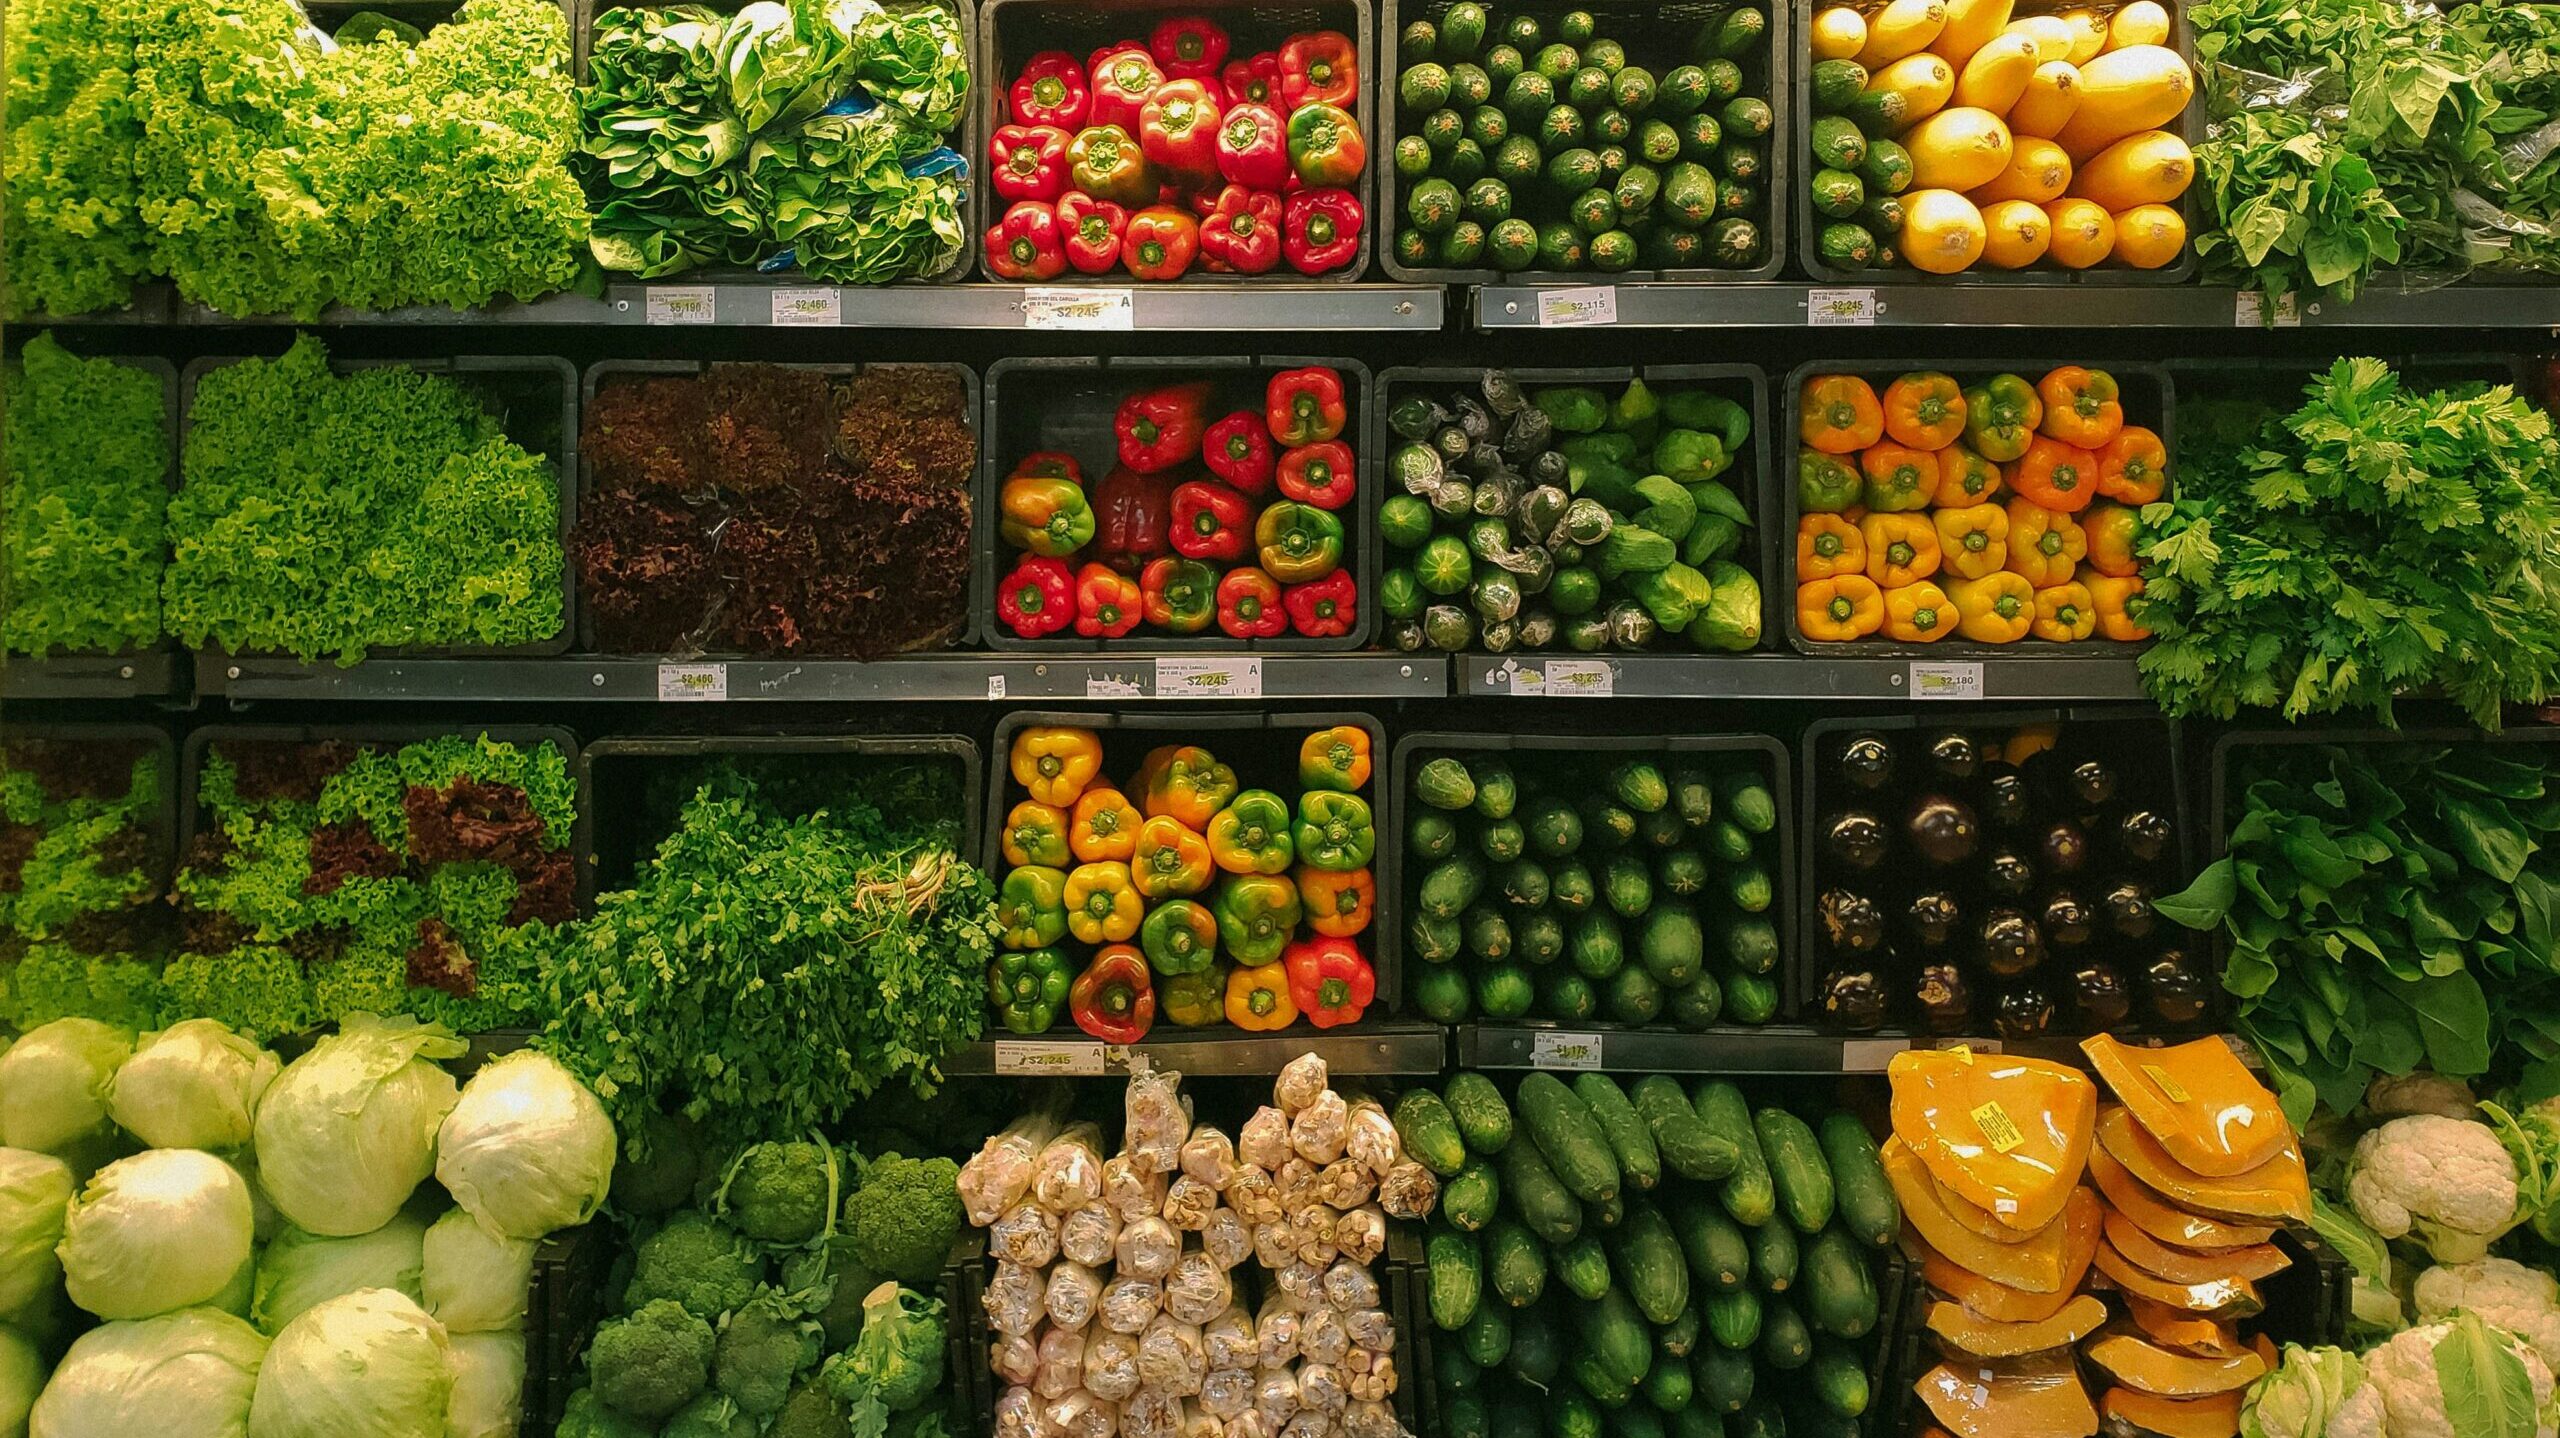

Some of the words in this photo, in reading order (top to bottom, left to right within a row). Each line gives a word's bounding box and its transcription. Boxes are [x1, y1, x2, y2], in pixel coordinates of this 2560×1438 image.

[795, 300, 827, 310] $2,460
[1121, 296, 1131, 307] A
[1832, 300, 1863, 311] $2,245
[669, 302, 702, 313] $5,190
[1249, 664, 1258, 675] A
[681, 674, 713, 684] $2,460
[1187, 676, 1229, 686] $2,245
[1572, 672, 1604, 683] $3,235
[1594, 1036, 1600, 1046] A
[1092, 1048, 1101, 1057] A
[1028, 1055, 1072, 1065] $2,245
